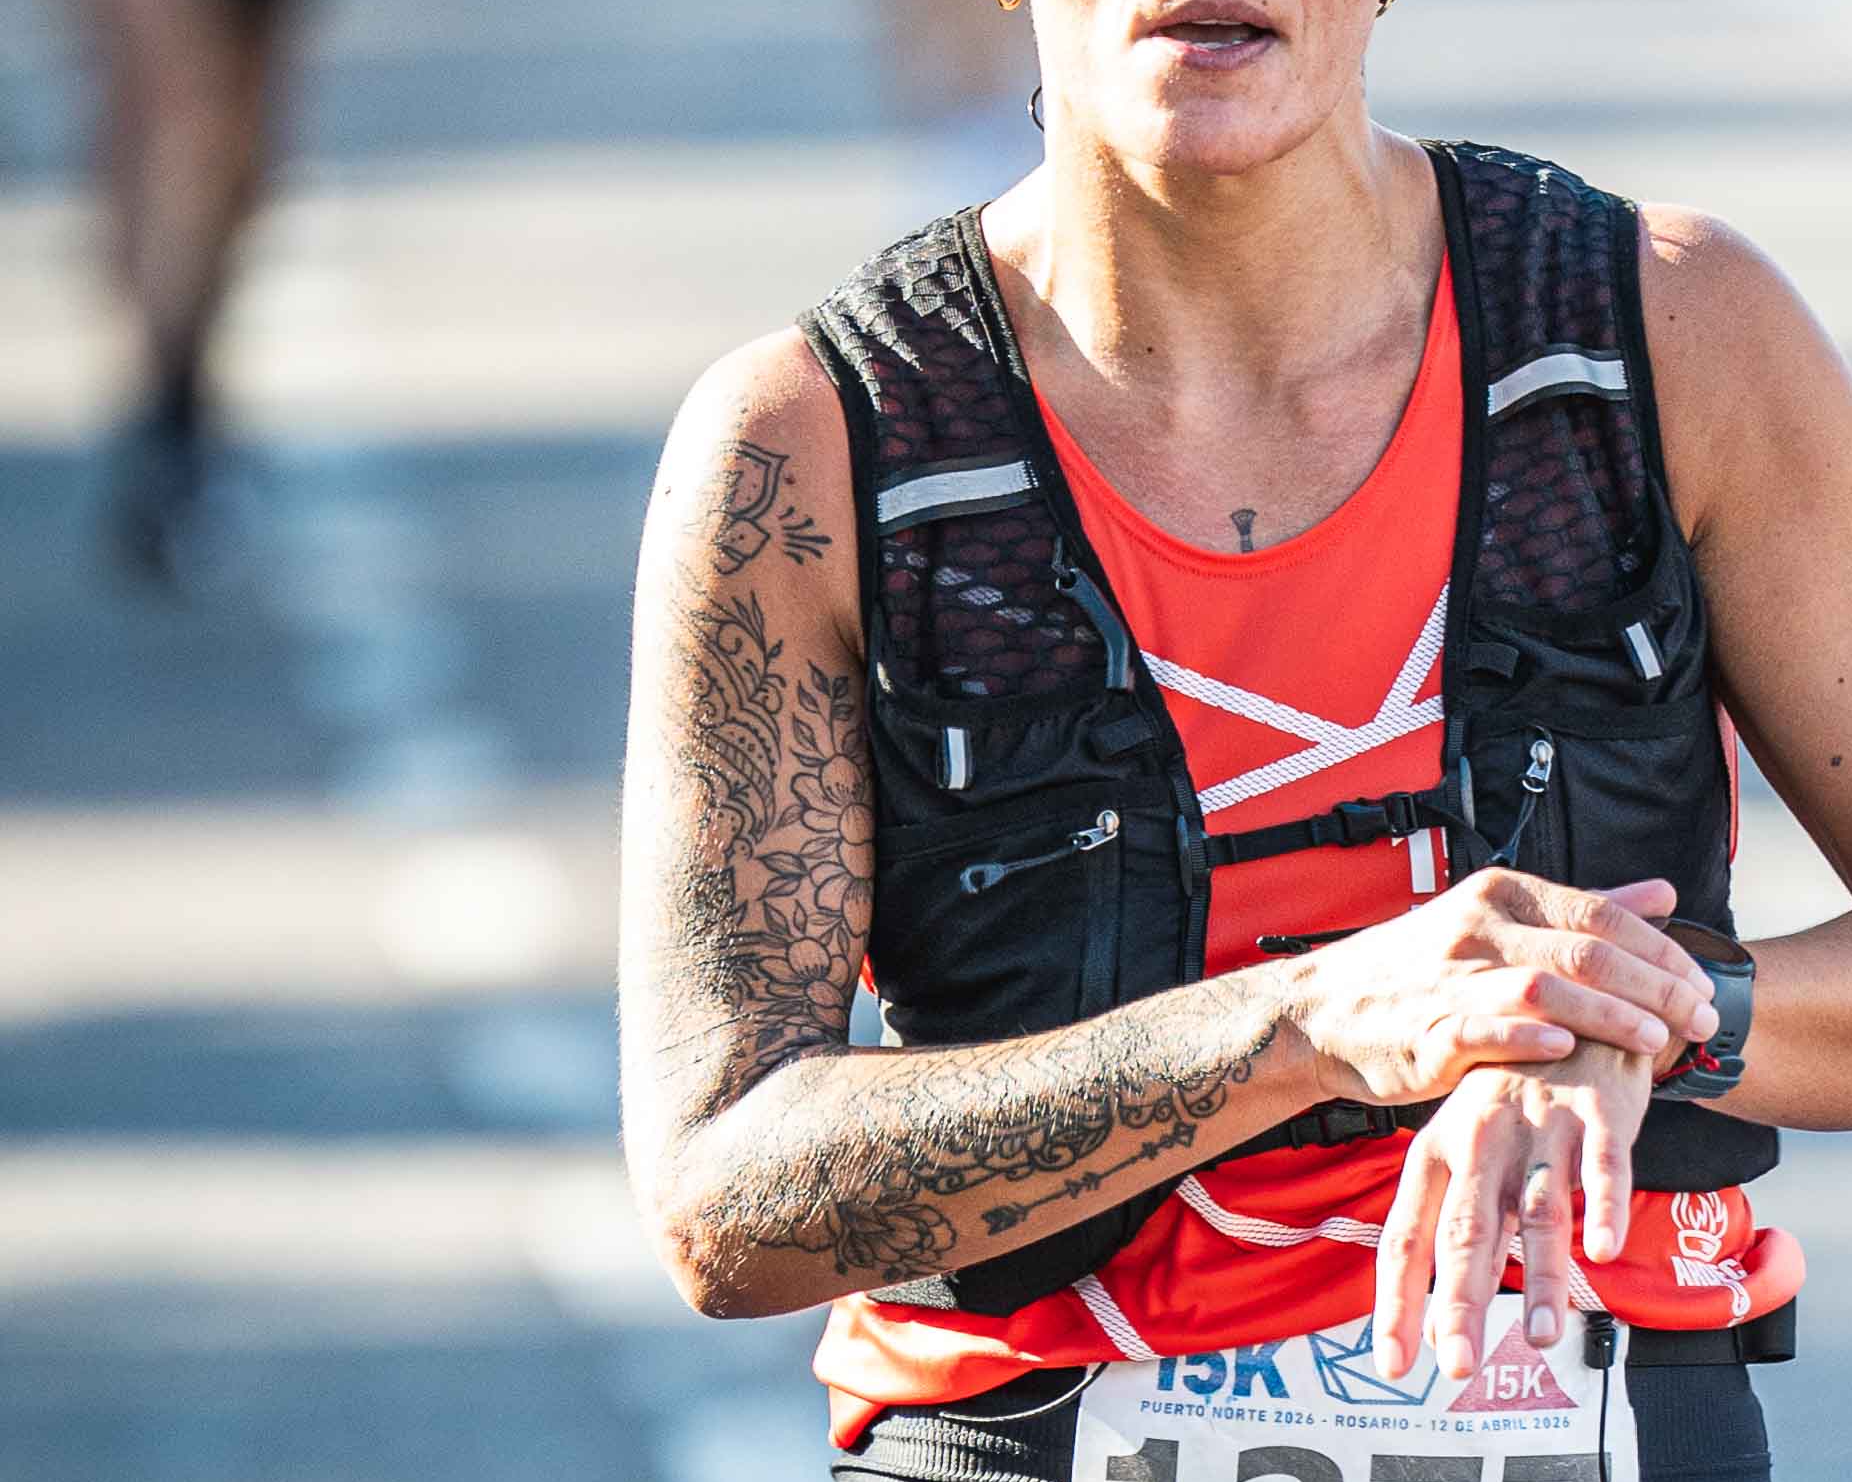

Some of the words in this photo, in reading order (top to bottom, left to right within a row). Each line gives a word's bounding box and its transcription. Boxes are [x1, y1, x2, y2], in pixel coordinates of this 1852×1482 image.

[1482, 1364, 1547, 1401] 15K
[1140, 1400, 1205, 1419] PUERTO
[1212, 1406, 1267, 1423] NORTE
[1273, 1410, 1315, 1426] 2026
[1335, 1414, 1409, 1431] ROSARIO
[1431, 1420, 1448, 1432] 12
[1455, 1420, 1474, 1433] DE
[1481, 1417, 1528, 1432] ABRIL
[1533, 1415, 1571, 1430] 2026
